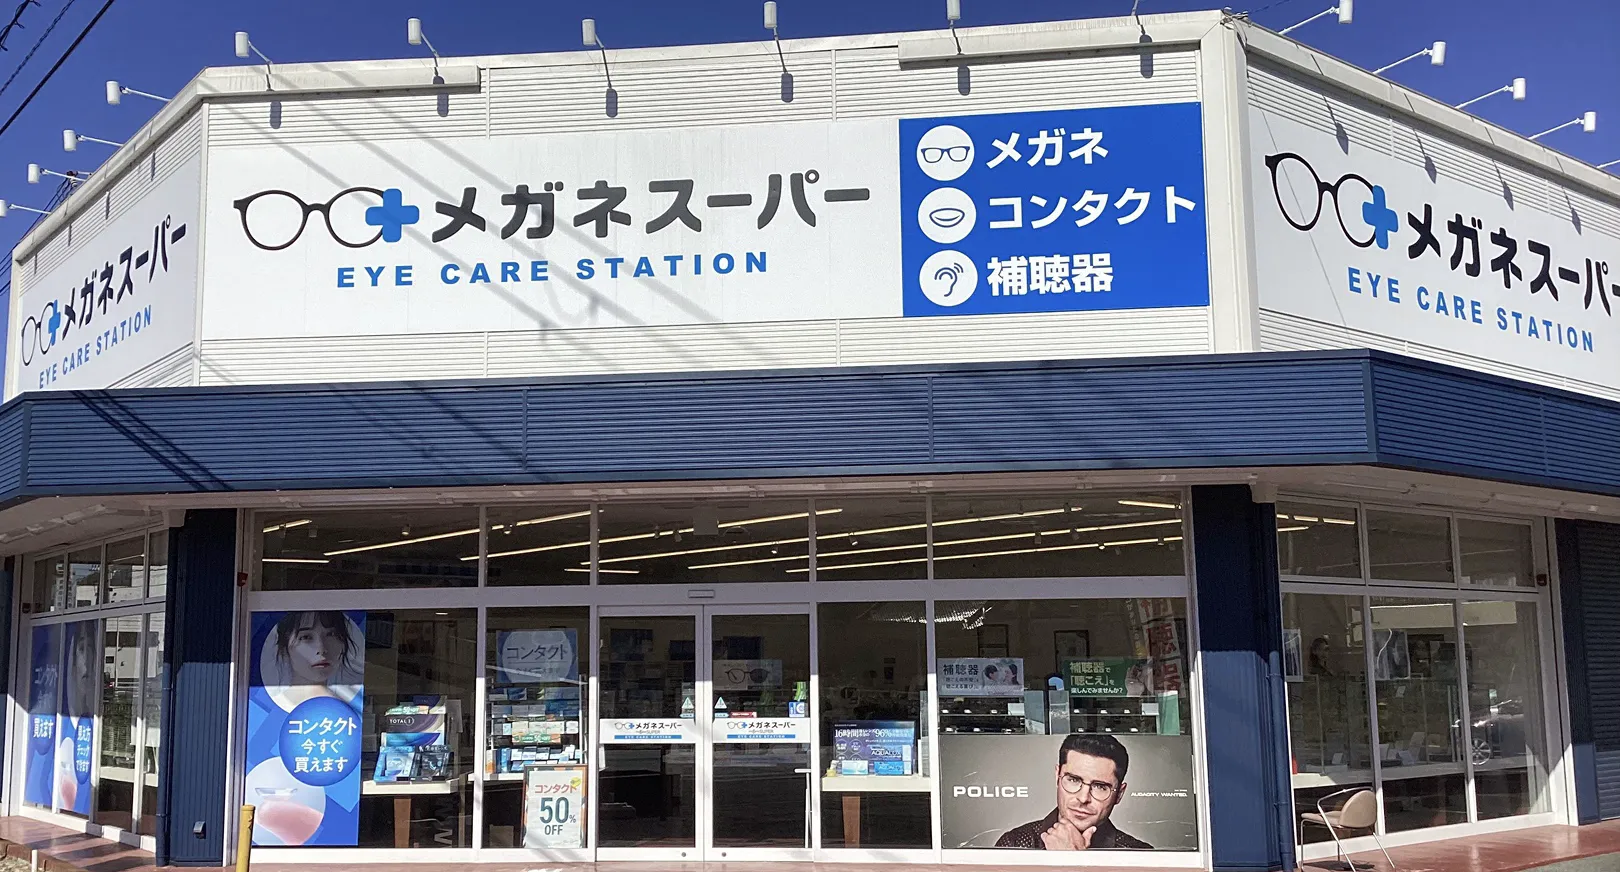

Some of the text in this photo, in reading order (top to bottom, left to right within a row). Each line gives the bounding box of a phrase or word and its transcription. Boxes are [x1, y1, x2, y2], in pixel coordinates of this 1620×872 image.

[986, 127, 1109, 169] メガネ
[432, 169, 870, 243] メガネスーパー
[989, 185, 1196, 229] コンタクト
[62, 214, 187, 341] メガネスーパー
[337, 251, 767, 288] EYE CARE STATION
[986, 252, 1113, 296] 補聴器
[1347, 266, 1594, 353] EYE CARE STATION
[39, 304, 152, 389] EYE CARE STATION
[506, 644, 567, 660] コンタクト
[943, 664, 979, 675] 補聴器
[1069, 662, 1111, 673] 補聴器で
[288, 717, 357, 736] コンタクト
[748, 721, 796, 729] メガネスーパー
[301, 738, 343, 755] 今すぐ
[294, 756, 348, 773] 買えます
[535, 784, 577, 794] コンタクト
[953, 785, 1029, 798] POLICE
[539, 797, 577, 824] 50%
[544, 825, 563, 835] OFF
